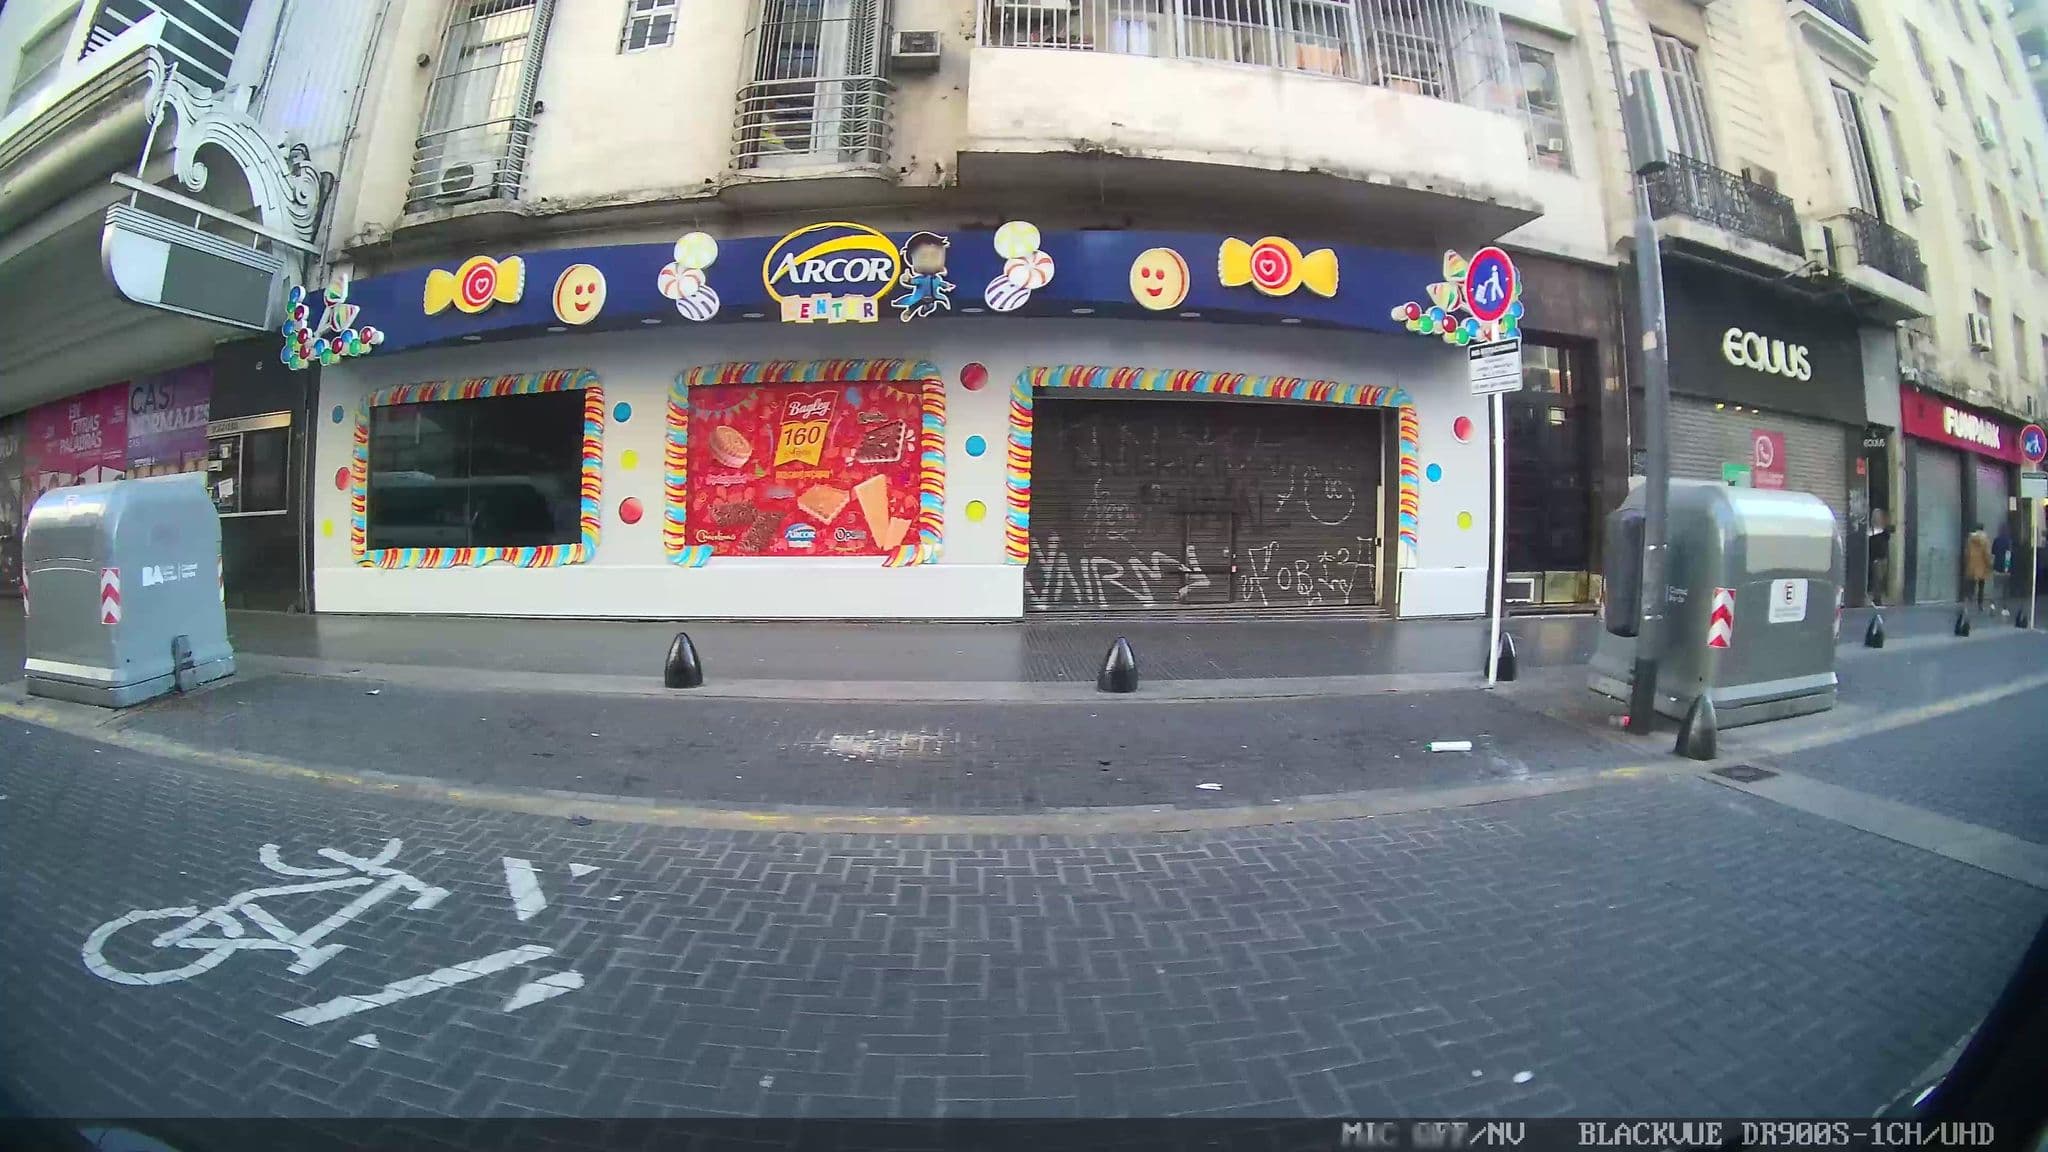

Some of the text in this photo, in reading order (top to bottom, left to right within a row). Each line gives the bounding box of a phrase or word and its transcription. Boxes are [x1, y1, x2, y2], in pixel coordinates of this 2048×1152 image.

[770, 253, 892, 284] ARCOR
[784, 298, 875, 319] ENTR
[1723, 327, 1811, 381] EQUUS
[789, 398, 831, 419] Bagley
[784, 426, 821, 446] 160
